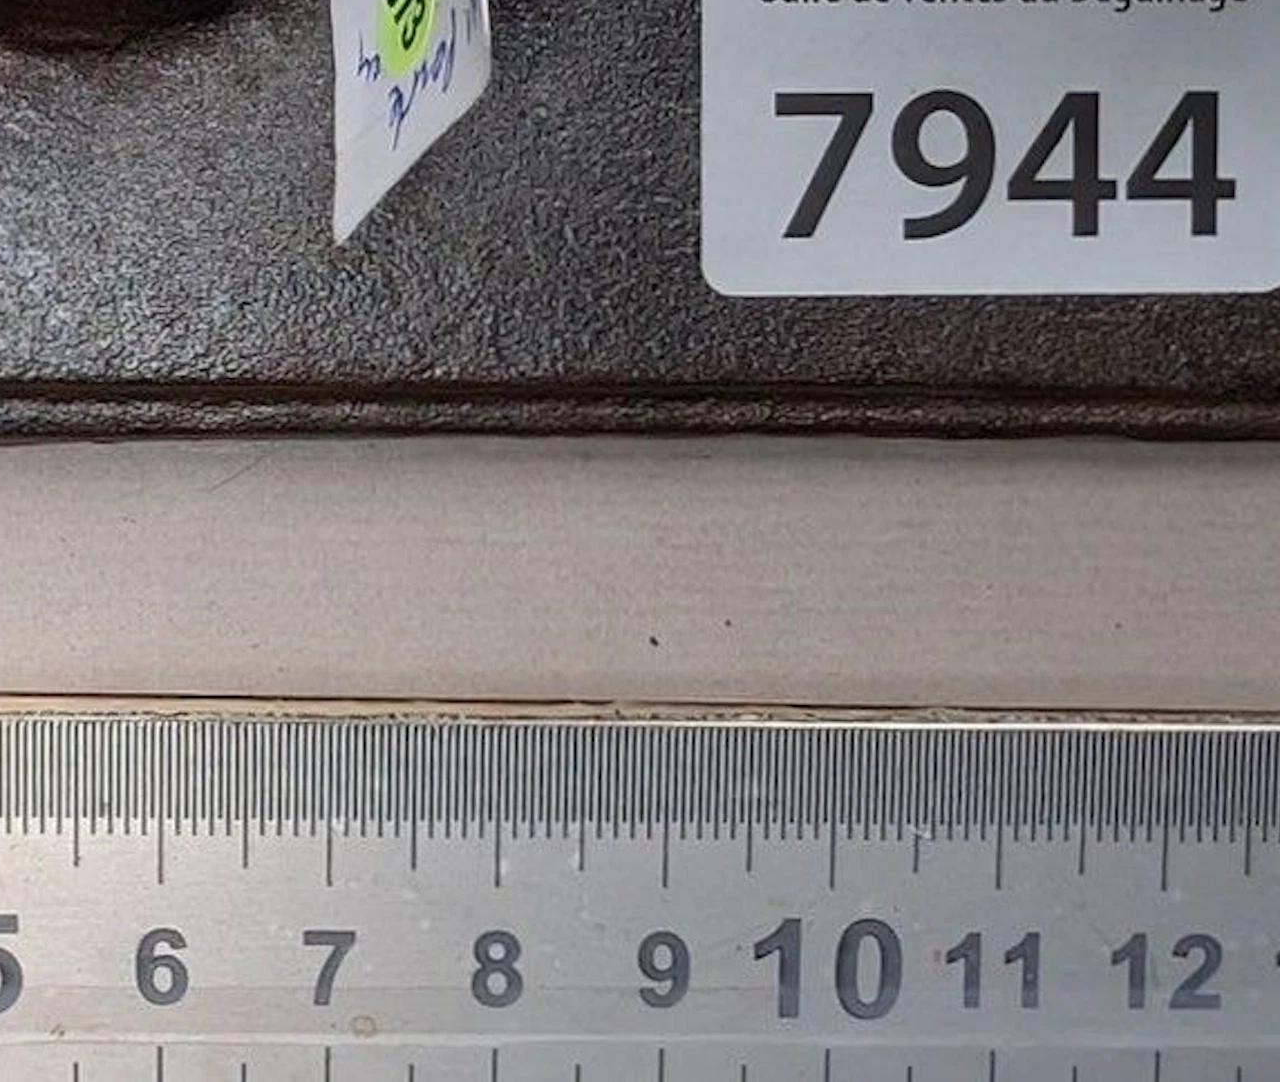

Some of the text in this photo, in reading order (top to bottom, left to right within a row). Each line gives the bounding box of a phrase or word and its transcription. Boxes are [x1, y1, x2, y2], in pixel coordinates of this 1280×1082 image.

[775, 89, 1237, 240] 7944
[135, 928, 188, 1006] 6
[303, 930, 356, 1006] 7
[471, 930, 523, 1008] 8
[637, 931, 690, 1009] 9
[754, 918, 902, 1020] 10
[946, 932, 1041, 1009] 11
[1111, 933, 1222, 1009] 12
